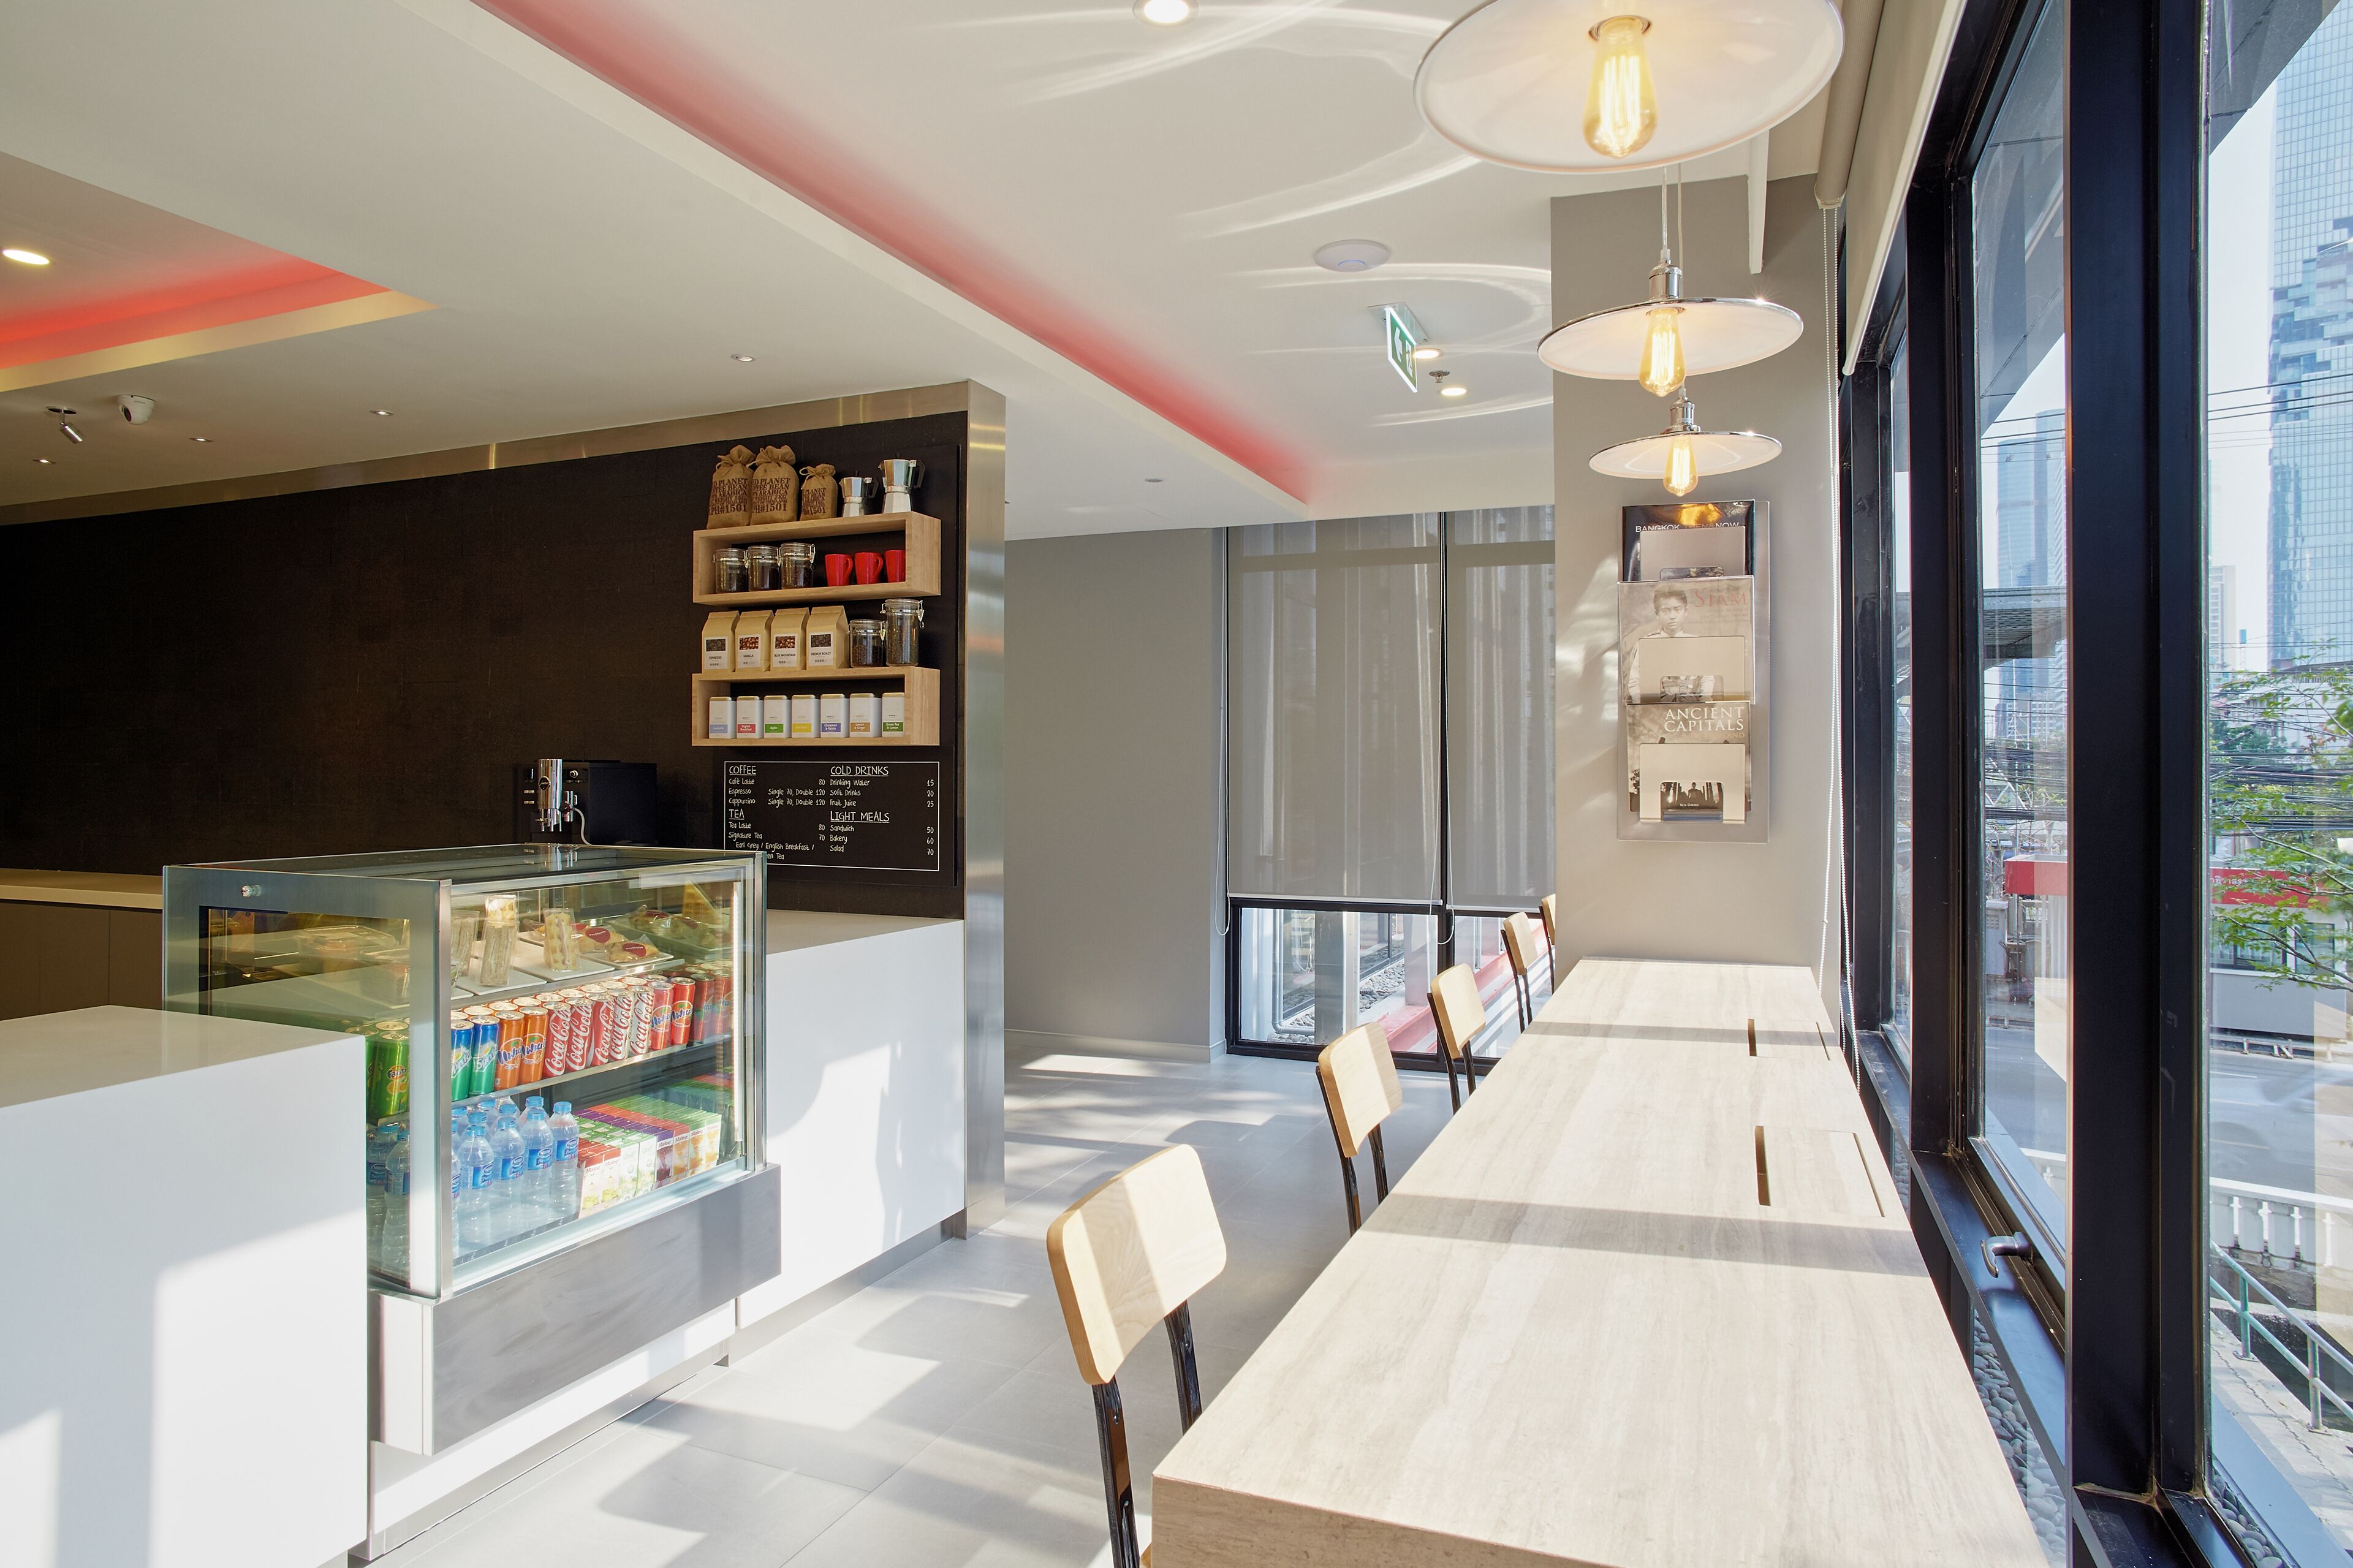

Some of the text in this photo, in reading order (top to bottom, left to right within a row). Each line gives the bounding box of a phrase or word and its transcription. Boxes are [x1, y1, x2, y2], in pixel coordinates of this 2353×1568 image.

[1635, 524, 1680, 532] BANGKOK
[1695, 589, 1747, 607] SIAM
[1665, 706, 1745, 720] ANCIENT
[1664, 719, 1744, 732] CAPITALS
[729, 765, 757, 775] COFFEE
[830, 765, 889, 775] COLD DRINKS
[830, 779, 851, 789] Drinking
[729, 787, 751, 797] Espresso
[768, 788, 784, 798] Single
[729, 798, 756, 806] Cappuccino
[768, 798, 784, 808] Single
[843, 800, 856, 808] Juice
[729, 808, 745, 819] TEA
[830, 811, 890, 822] LIGHT MEALS
[728, 832, 751, 841] Signature
[830, 835, 847, 844] Bakery
[766, 843, 783, 852] English
[387, 1068, 407, 1079] Fanta
